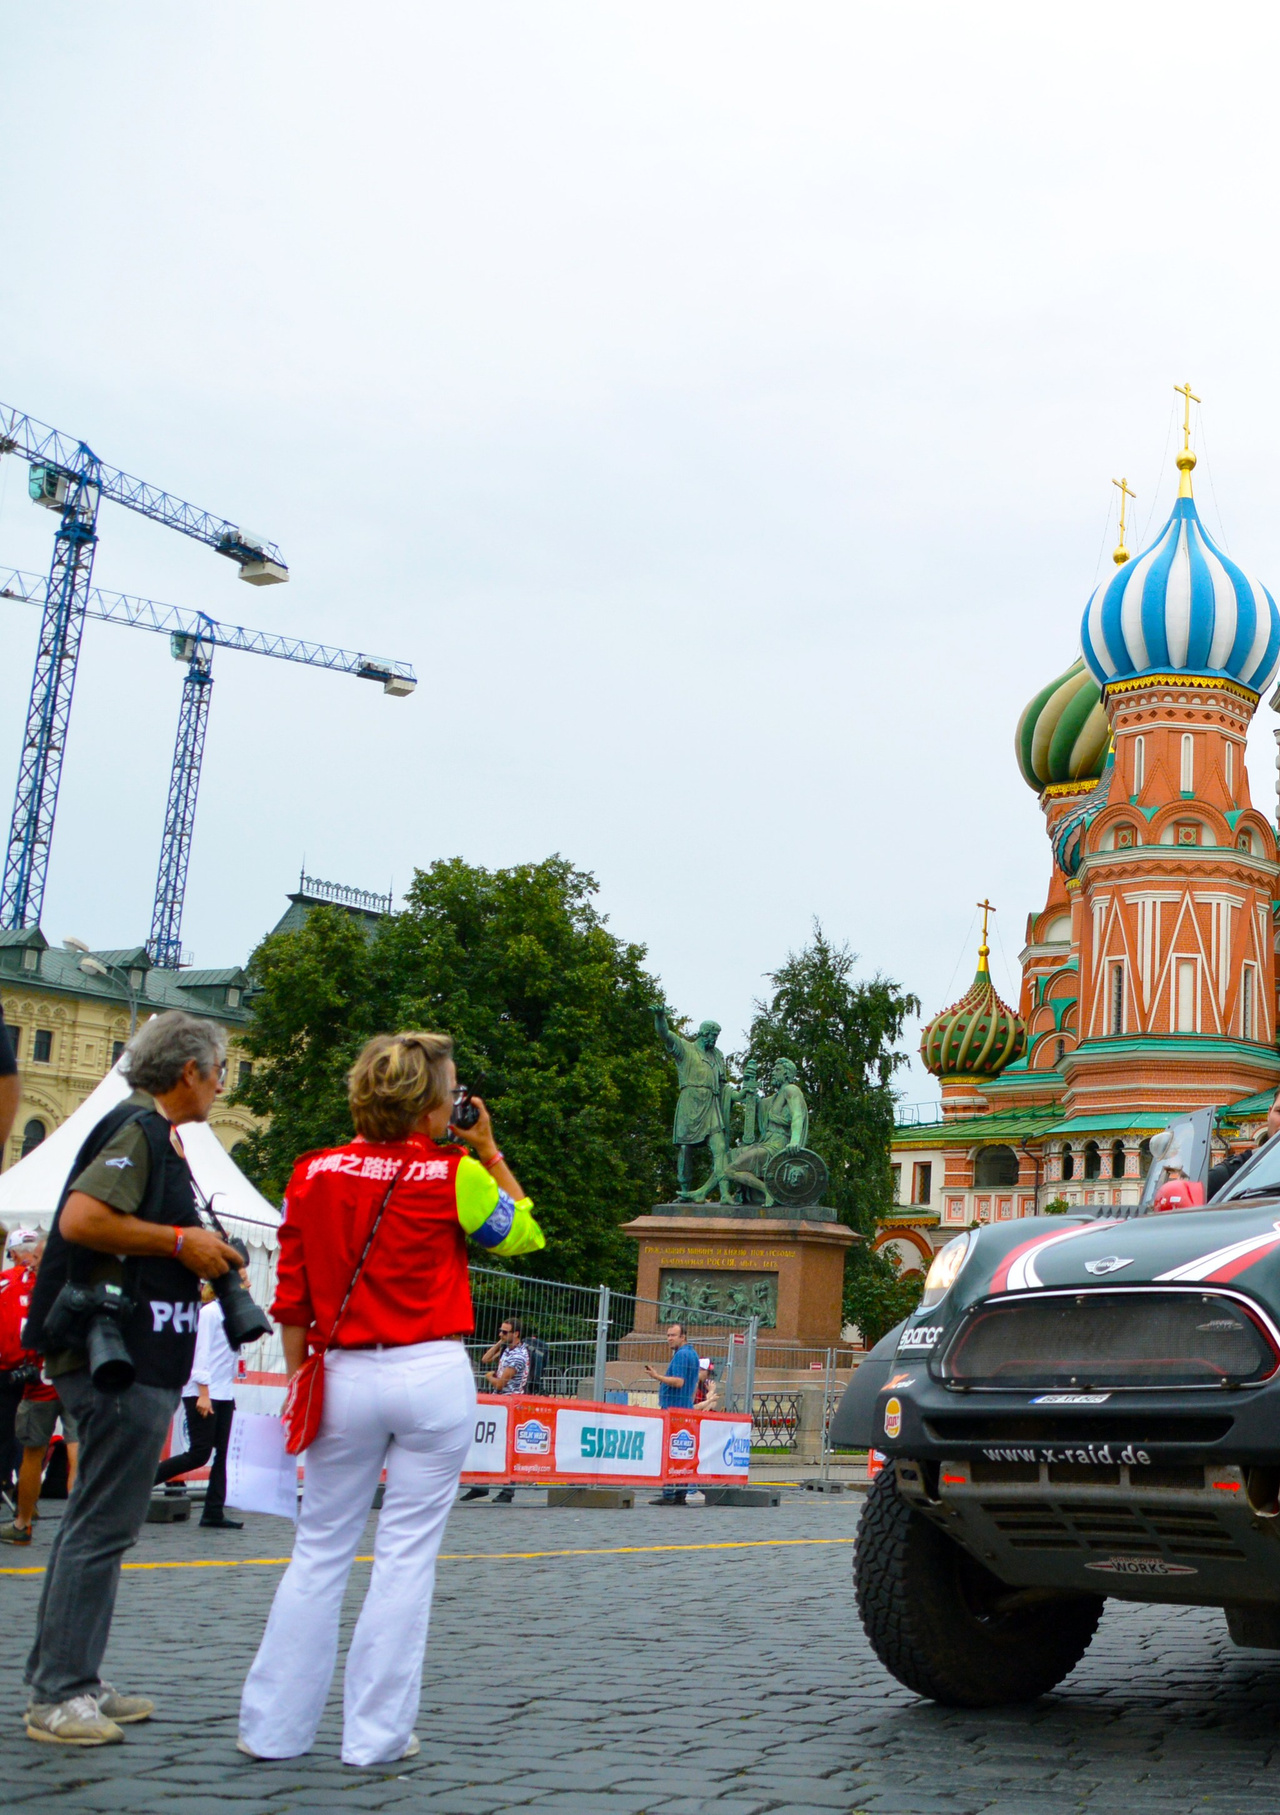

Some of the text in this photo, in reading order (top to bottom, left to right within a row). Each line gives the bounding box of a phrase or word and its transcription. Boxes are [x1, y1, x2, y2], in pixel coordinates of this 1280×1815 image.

[519, 1431, 547, 1440] SILK WAY
[580, 1426, 645, 1461] SIBUR
[983, 1444, 1151, 1465] www.x-raid.de
[1112, 1562, 1169, 1574] WORKS
